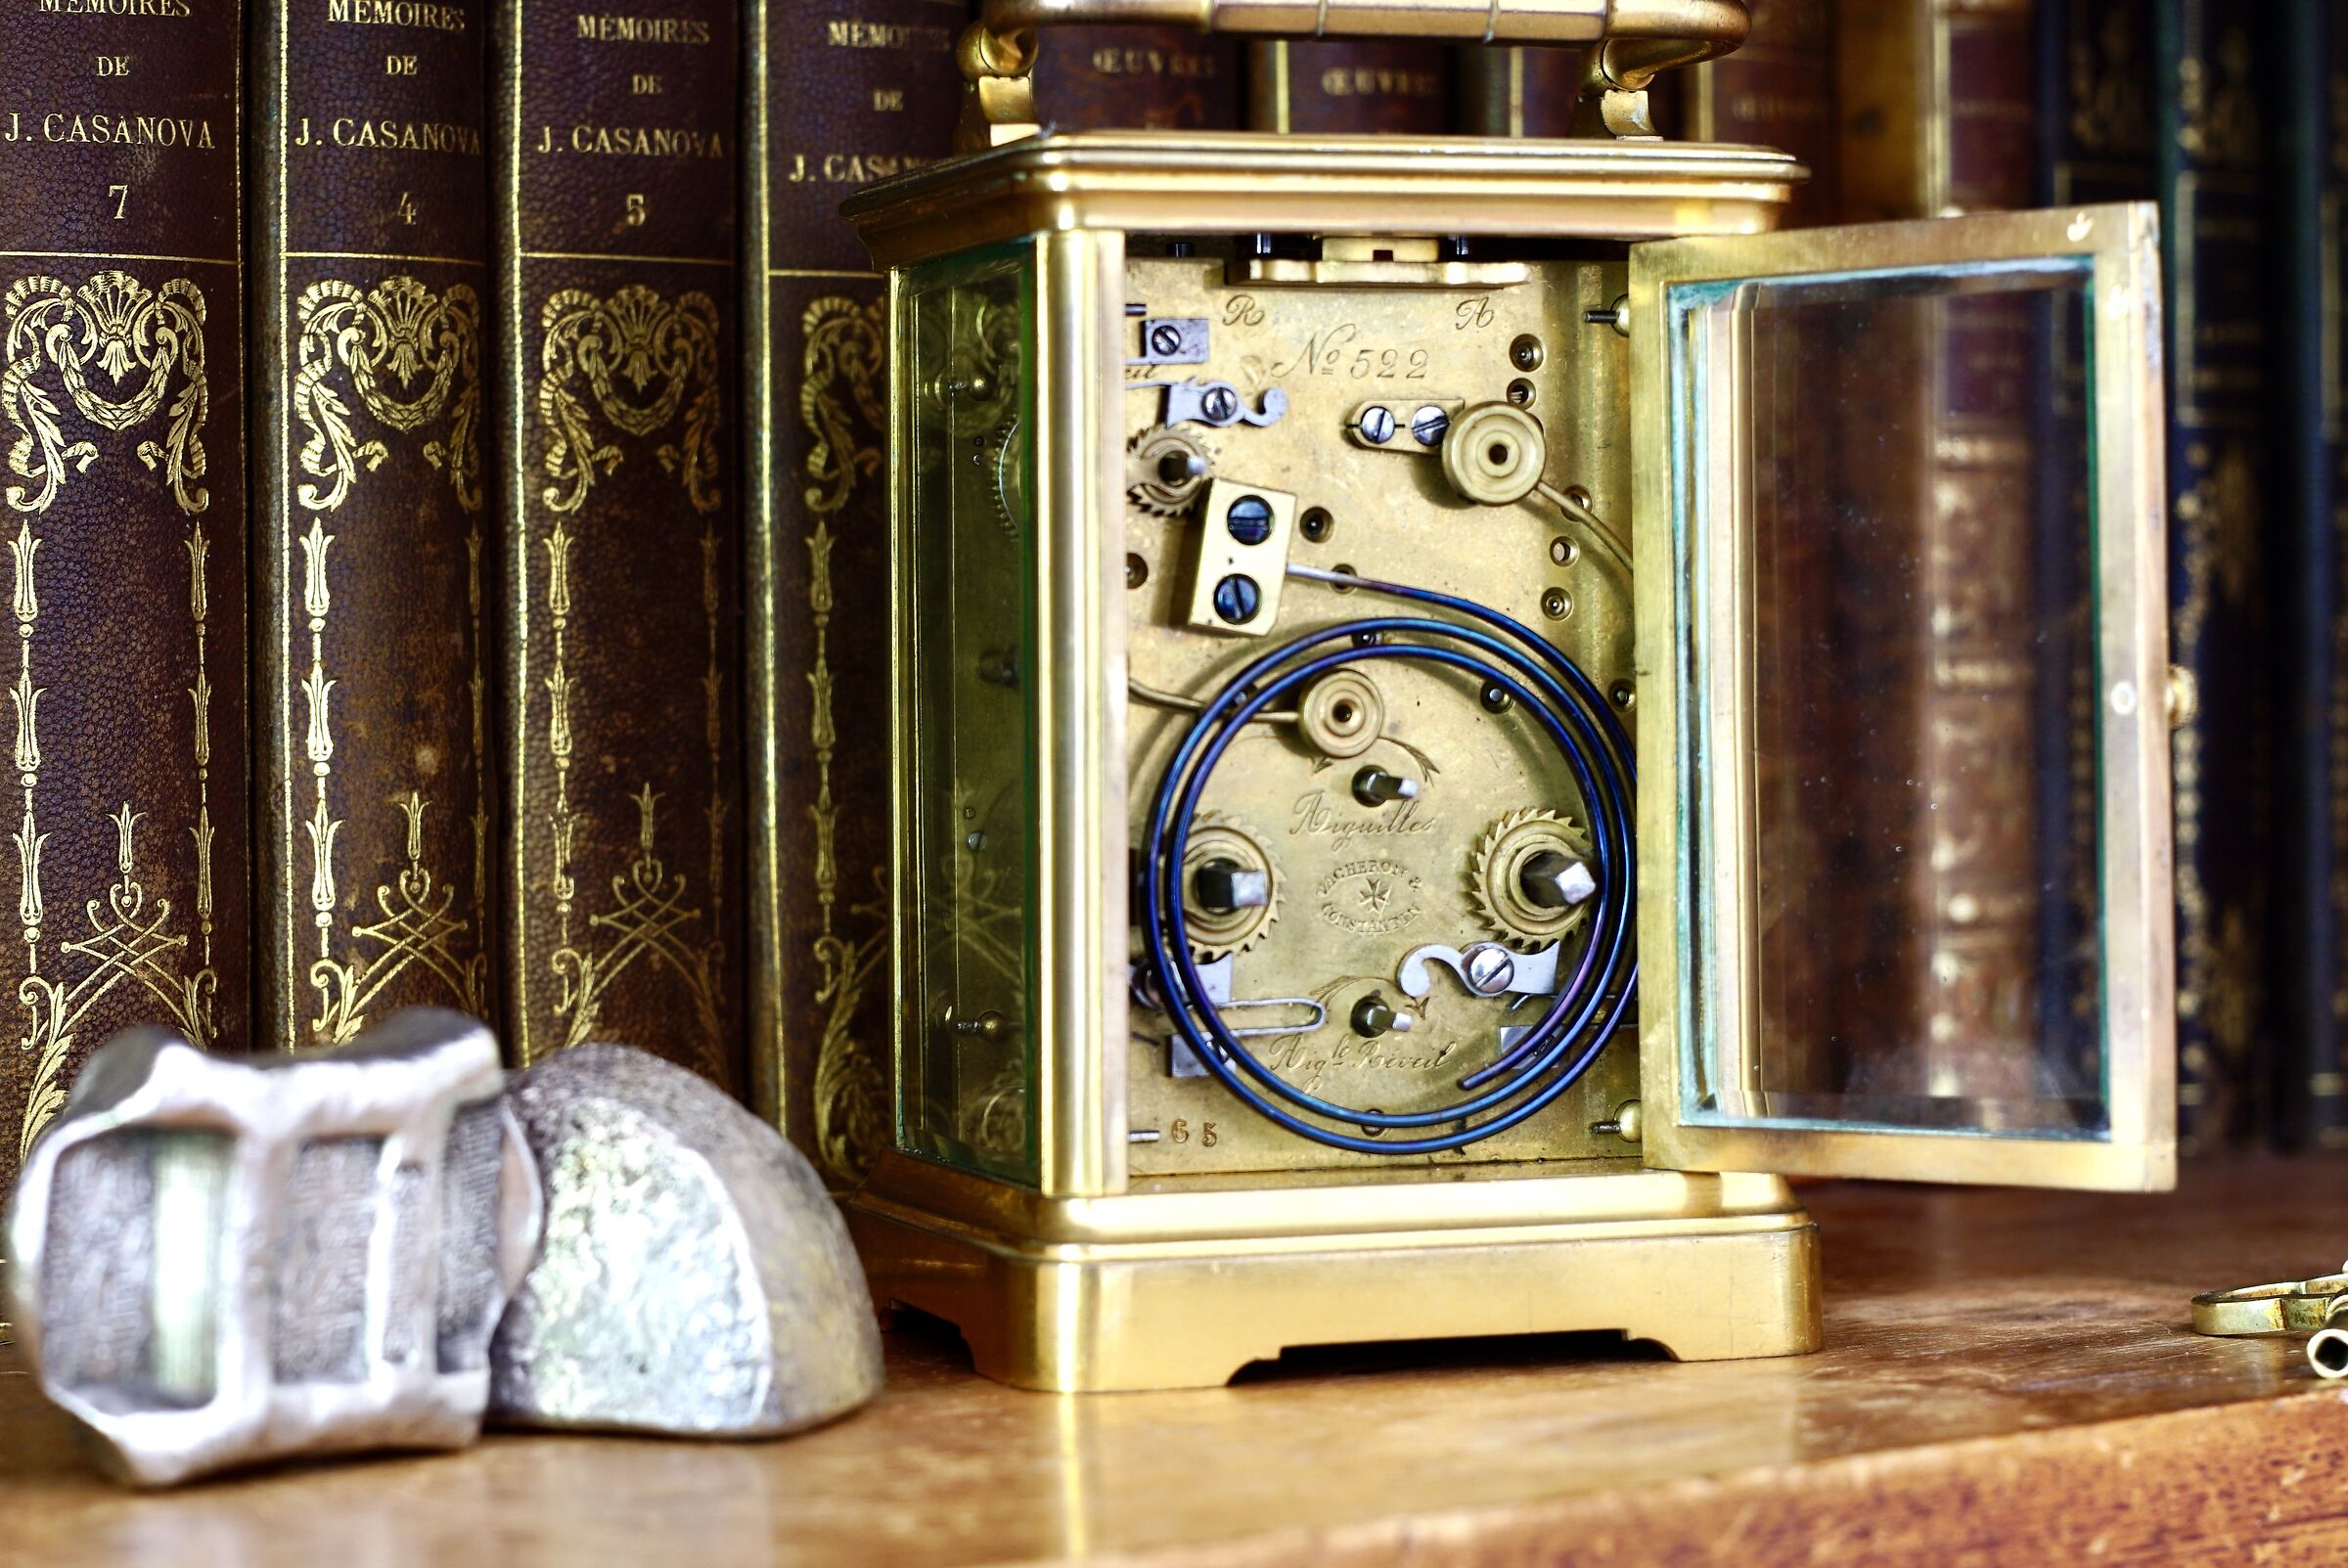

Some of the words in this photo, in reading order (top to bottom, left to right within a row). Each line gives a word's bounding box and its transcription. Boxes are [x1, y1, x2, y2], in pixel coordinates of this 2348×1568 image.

[828, 17, 951, 51] MÉMO
[96, 56, 130, 76] DE
[385, 55, 418, 75] DE
[632, 74, 662, 94] DE
[874, 89, 904, 111] DE
[5, 112, 33, 142] J.
[43, 112, 215, 150] CASANOVA
[295, 117, 323, 146] J.
[333, 117, 481, 155] CASANOVA
[538, 125, 564, 154] J.
[571, 124, 723, 158] CASANOVA
[789, 155, 817, 183] J.
[109, 184, 128, 220] 7
[397, 191, 417, 226] 4
[626, 194, 646, 226] 5
[1455, 296, 1495, 331] A
[1350, 349, 1429, 380] 522
[1288, 788, 1436, 852] Aiguilles
